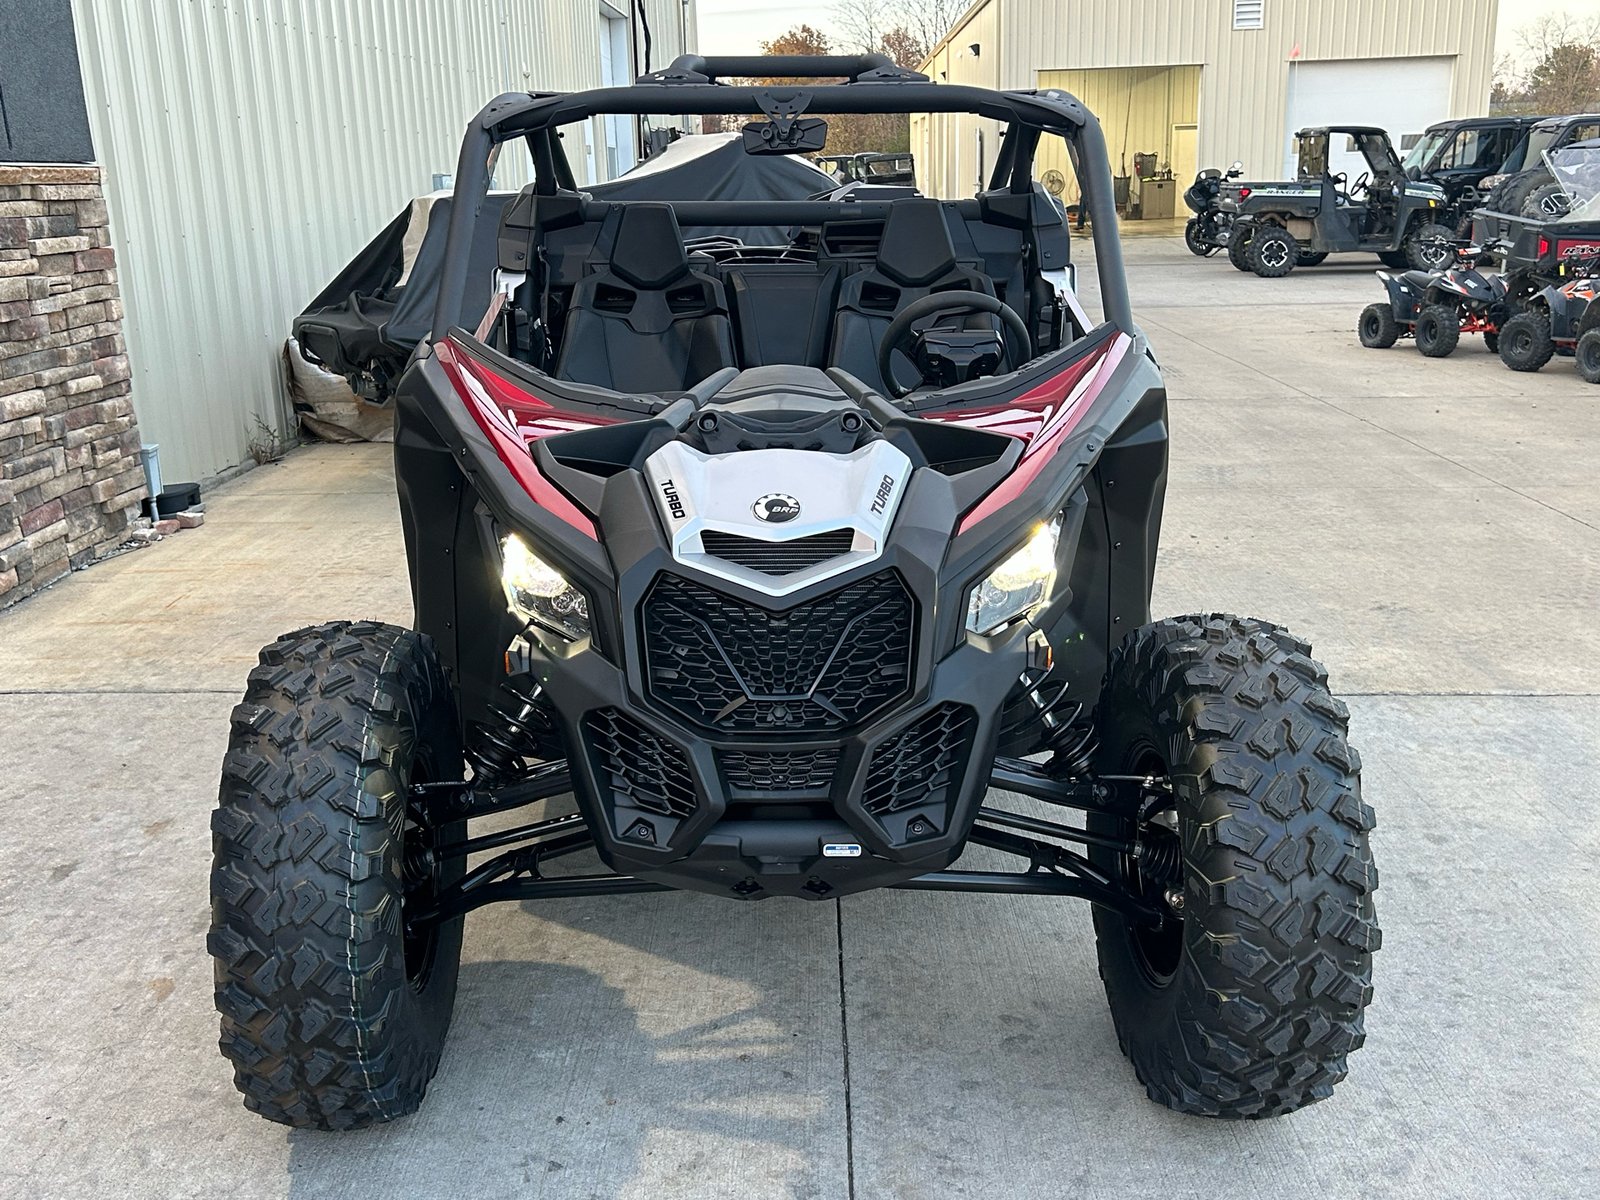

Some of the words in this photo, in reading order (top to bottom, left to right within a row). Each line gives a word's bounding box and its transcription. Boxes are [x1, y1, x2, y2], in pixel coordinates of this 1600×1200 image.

[661, 479, 686, 519] TURBO
[771, 506, 799, 514] BRP
[871, 474, 895, 515] TURBO
